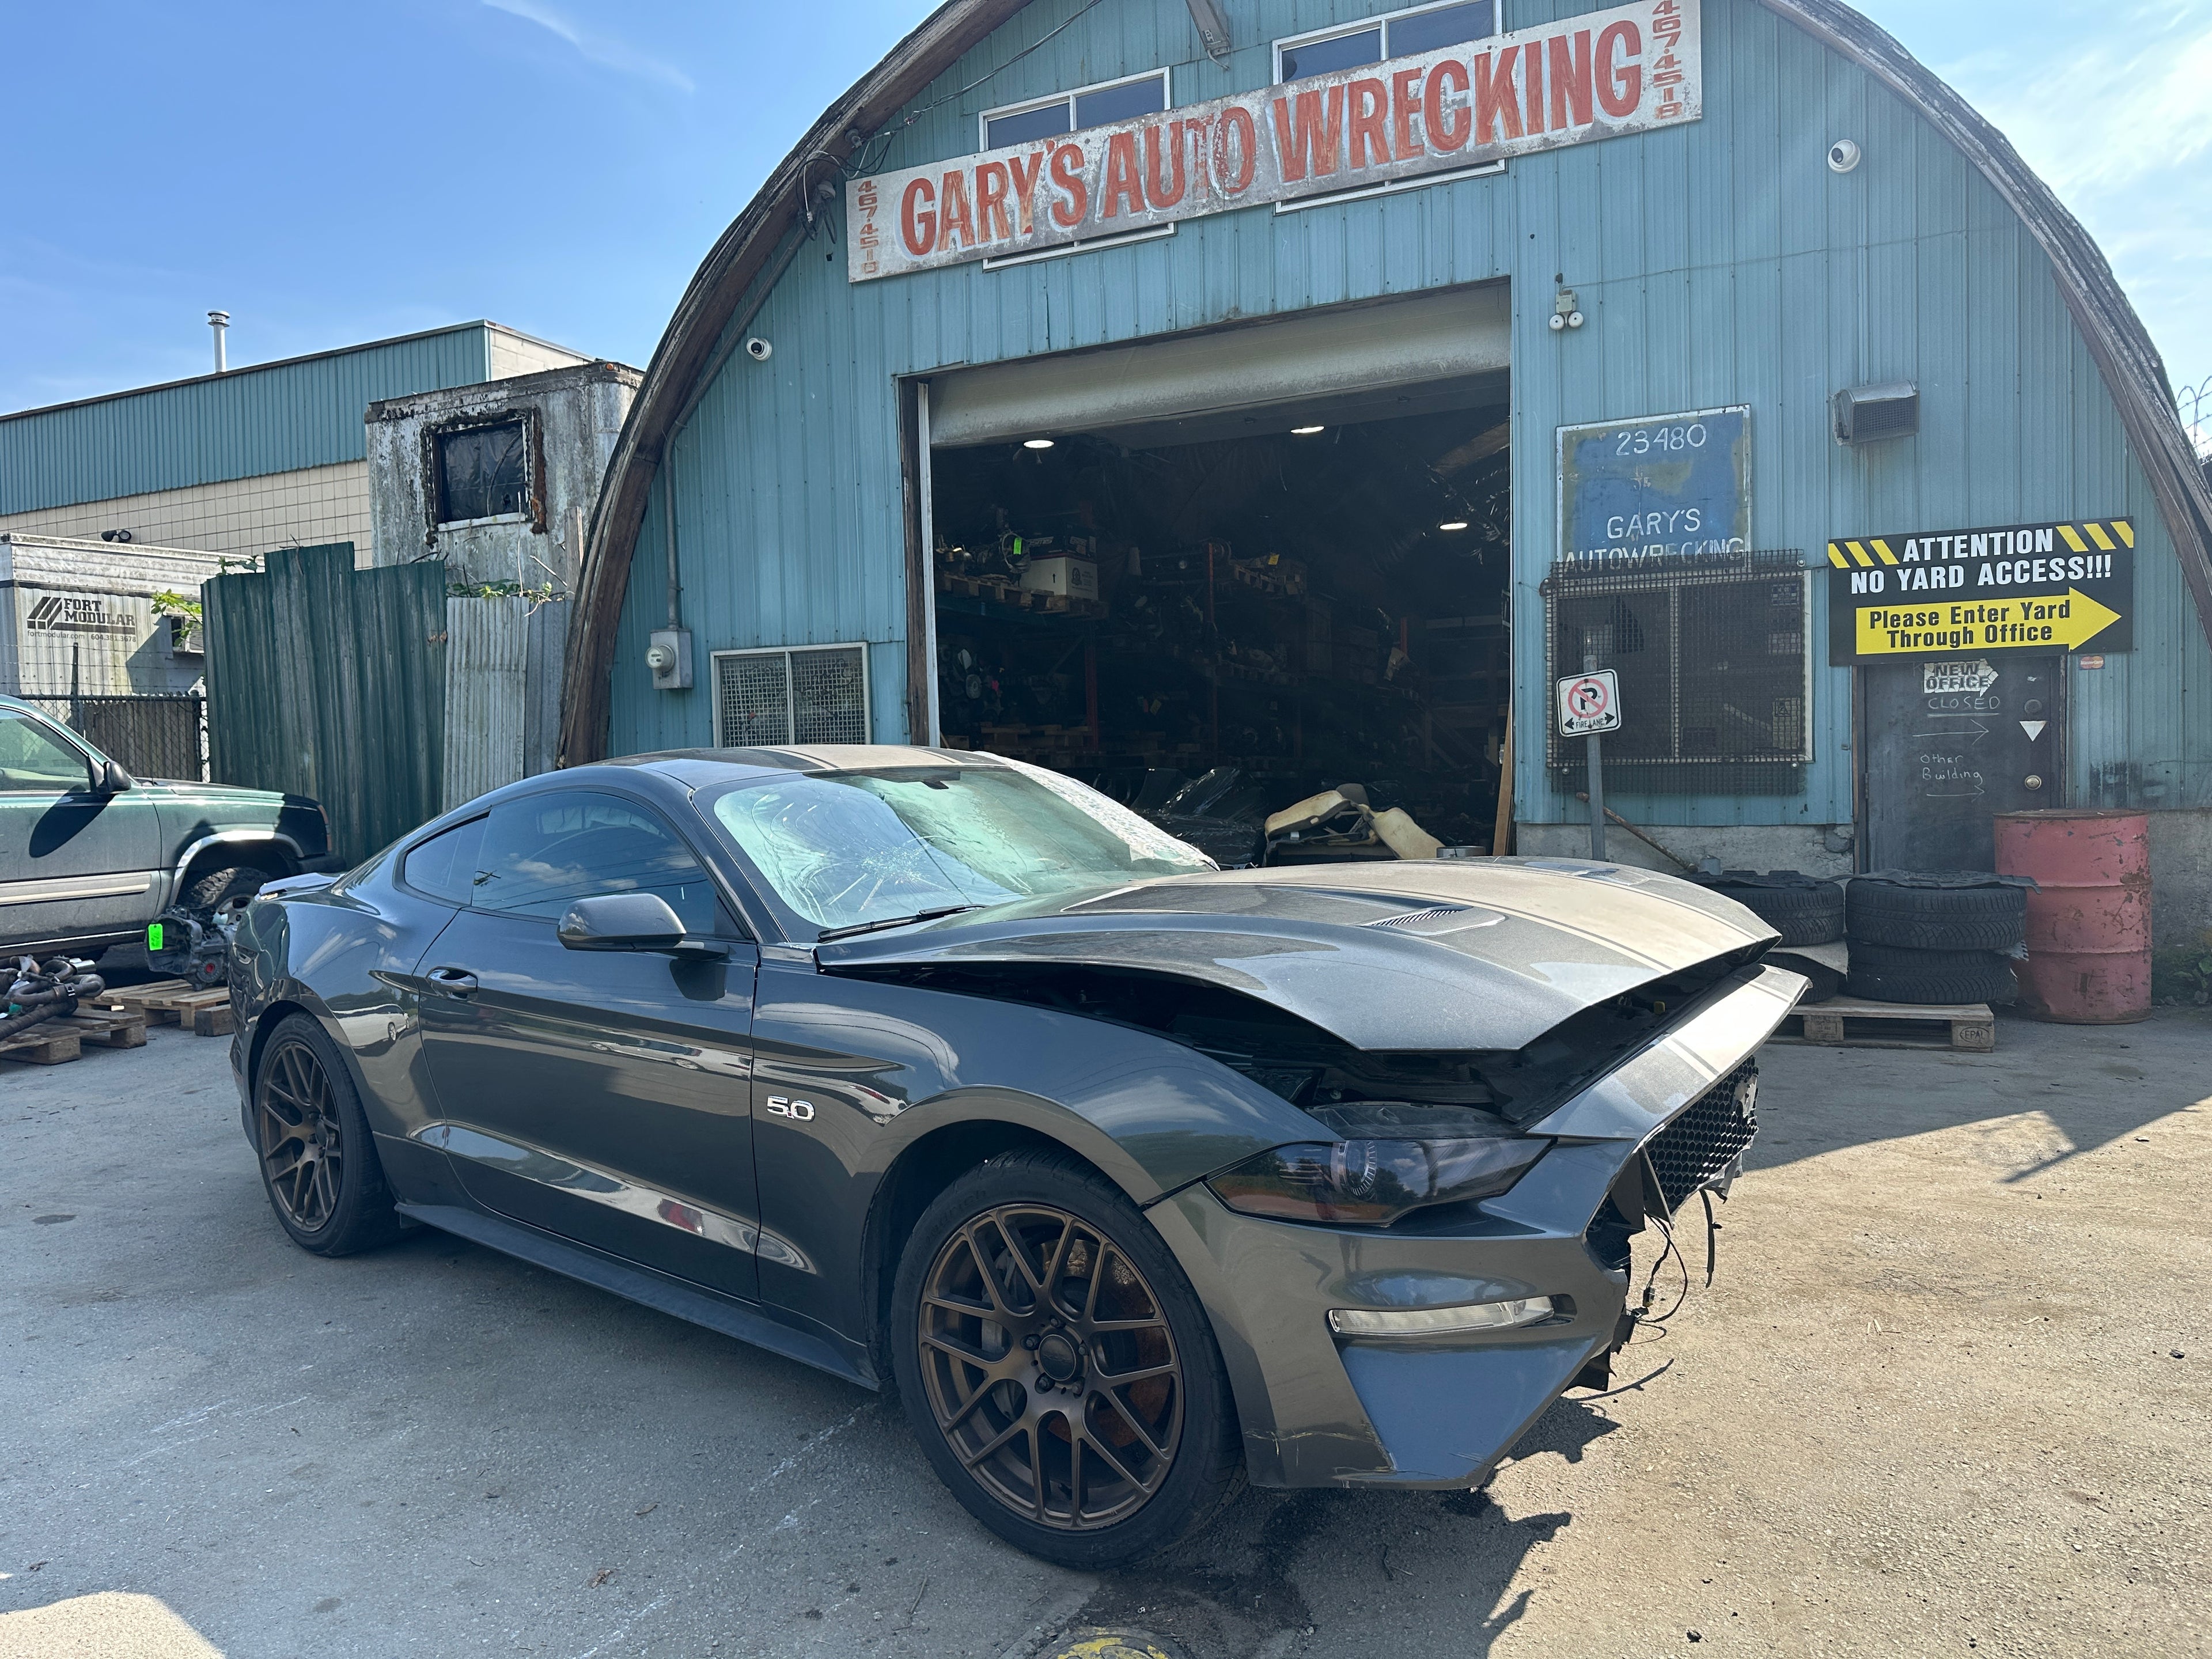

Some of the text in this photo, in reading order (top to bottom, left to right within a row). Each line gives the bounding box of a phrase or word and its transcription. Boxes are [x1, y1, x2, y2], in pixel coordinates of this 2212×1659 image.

[901, 20, 1642, 256] GARY'S AUTO WRECKING
[1616, 423, 1707, 456] 23480
[1607, 507, 1701, 539] GARY'S
[1902, 528, 2054, 562] ATTENTION
[1851, 555, 2111, 594] NO YARD ACCESS!!!
[63, 598, 102, 612] FORT
[1870, 599, 2070, 630] Please Enter Yard
[64, 610, 135, 626] MODULAR
[28, 630, 85, 639] fortmodular.com
[1887, 623, 2052, 649] Through Office
[1935, 664, 1978, 676] NEW
[1926, 676, 1989, 690] OFFICE
[1928, 696, 2000, 710] CLOSED
[1575, 721, 1588, 729] FIRE
[1922, 767, 1983, 786] Building
[1964, 1030, 1986, 1040] EPAL
[767, 1095, 815, 1122] 5.0
